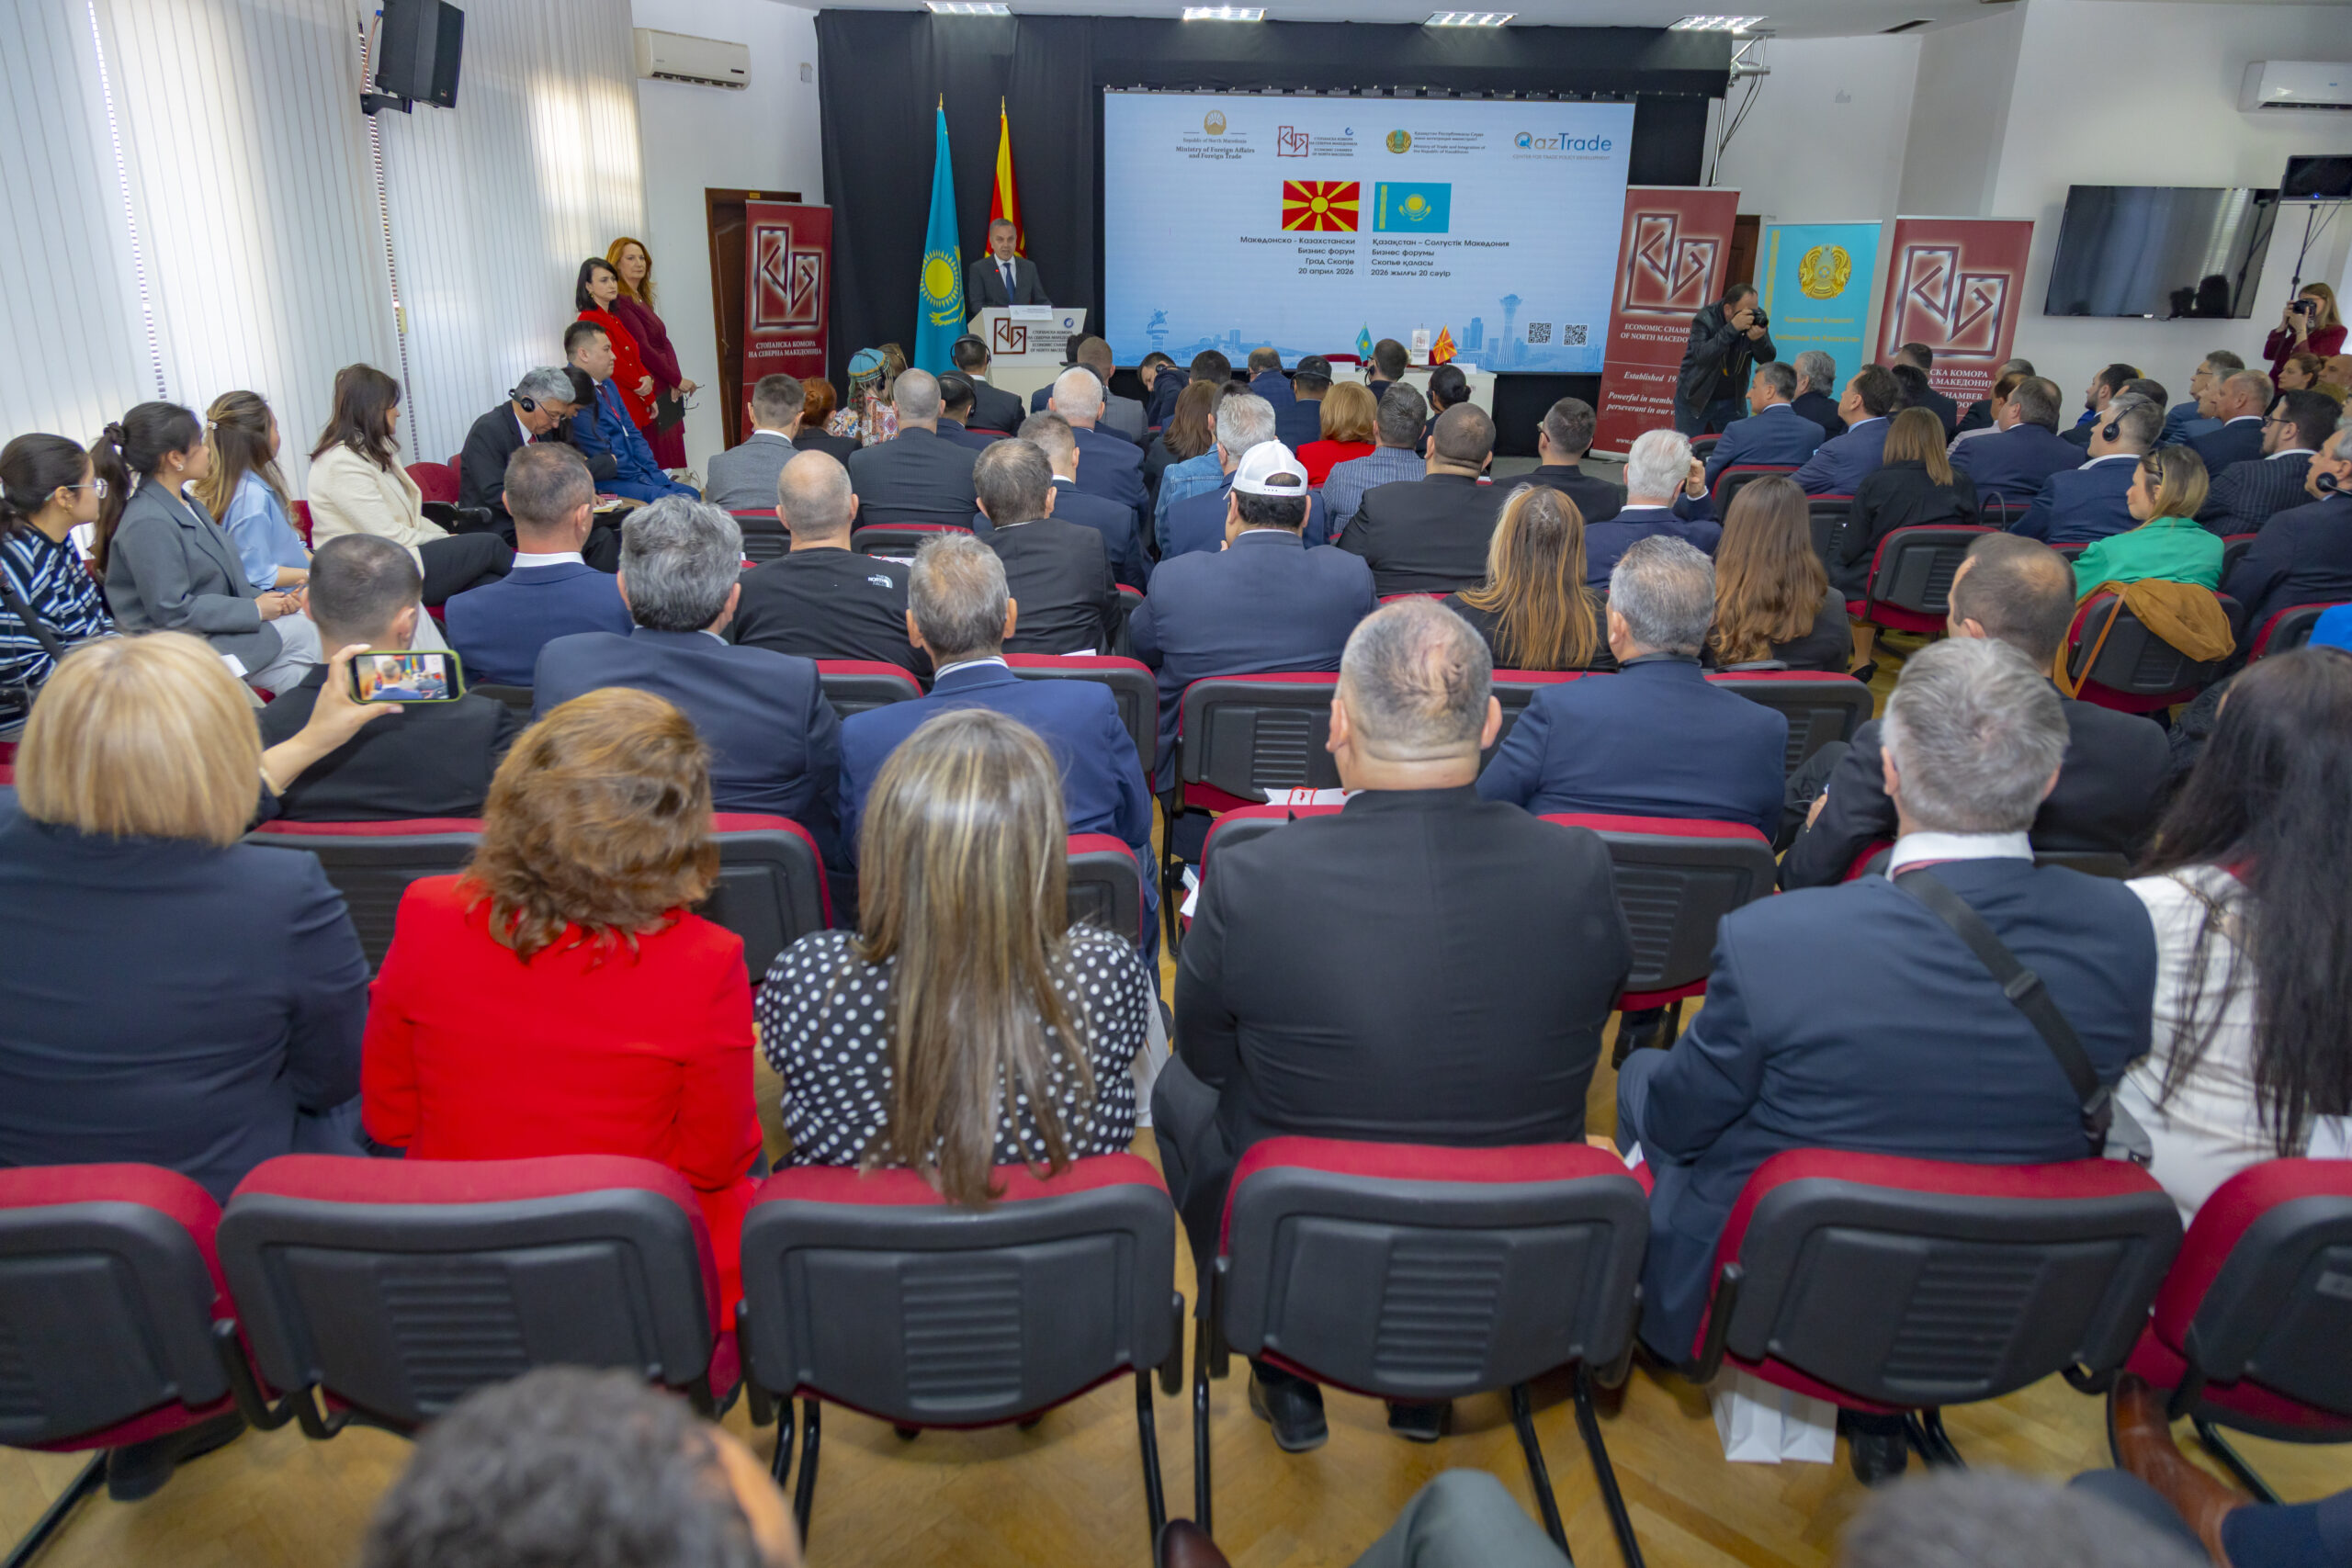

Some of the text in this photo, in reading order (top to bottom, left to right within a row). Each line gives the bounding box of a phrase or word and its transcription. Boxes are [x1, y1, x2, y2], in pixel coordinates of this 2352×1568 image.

[1514, 131, 1611, 152] QazTrade
[1176, 146, 1202, 154] Ministry
[1464, 240, 1510, 248] Македония
[1328, 247, 1355, 255] форум
[1402, 249, 1435, 257] форумы
[1327, 258, 1354, 266] Скопје
[1624, 323, 1690, 334] ECONOMIC CHAMB
[1631, 333, 1656, 341] NORTH
[1657, 334, 1689, 343] MACEDO
[1624, 371, 1665, 382] Established
[1950, 369, 1988, 378] КОМОРА
[1935, 378, 1992, 389] МАКЕДОНИЈ
[1608, 391, 1639, 402] Powerful
[1640, 394, 1648, 402] in
[1606, 404, 1646, 412] perseverant
